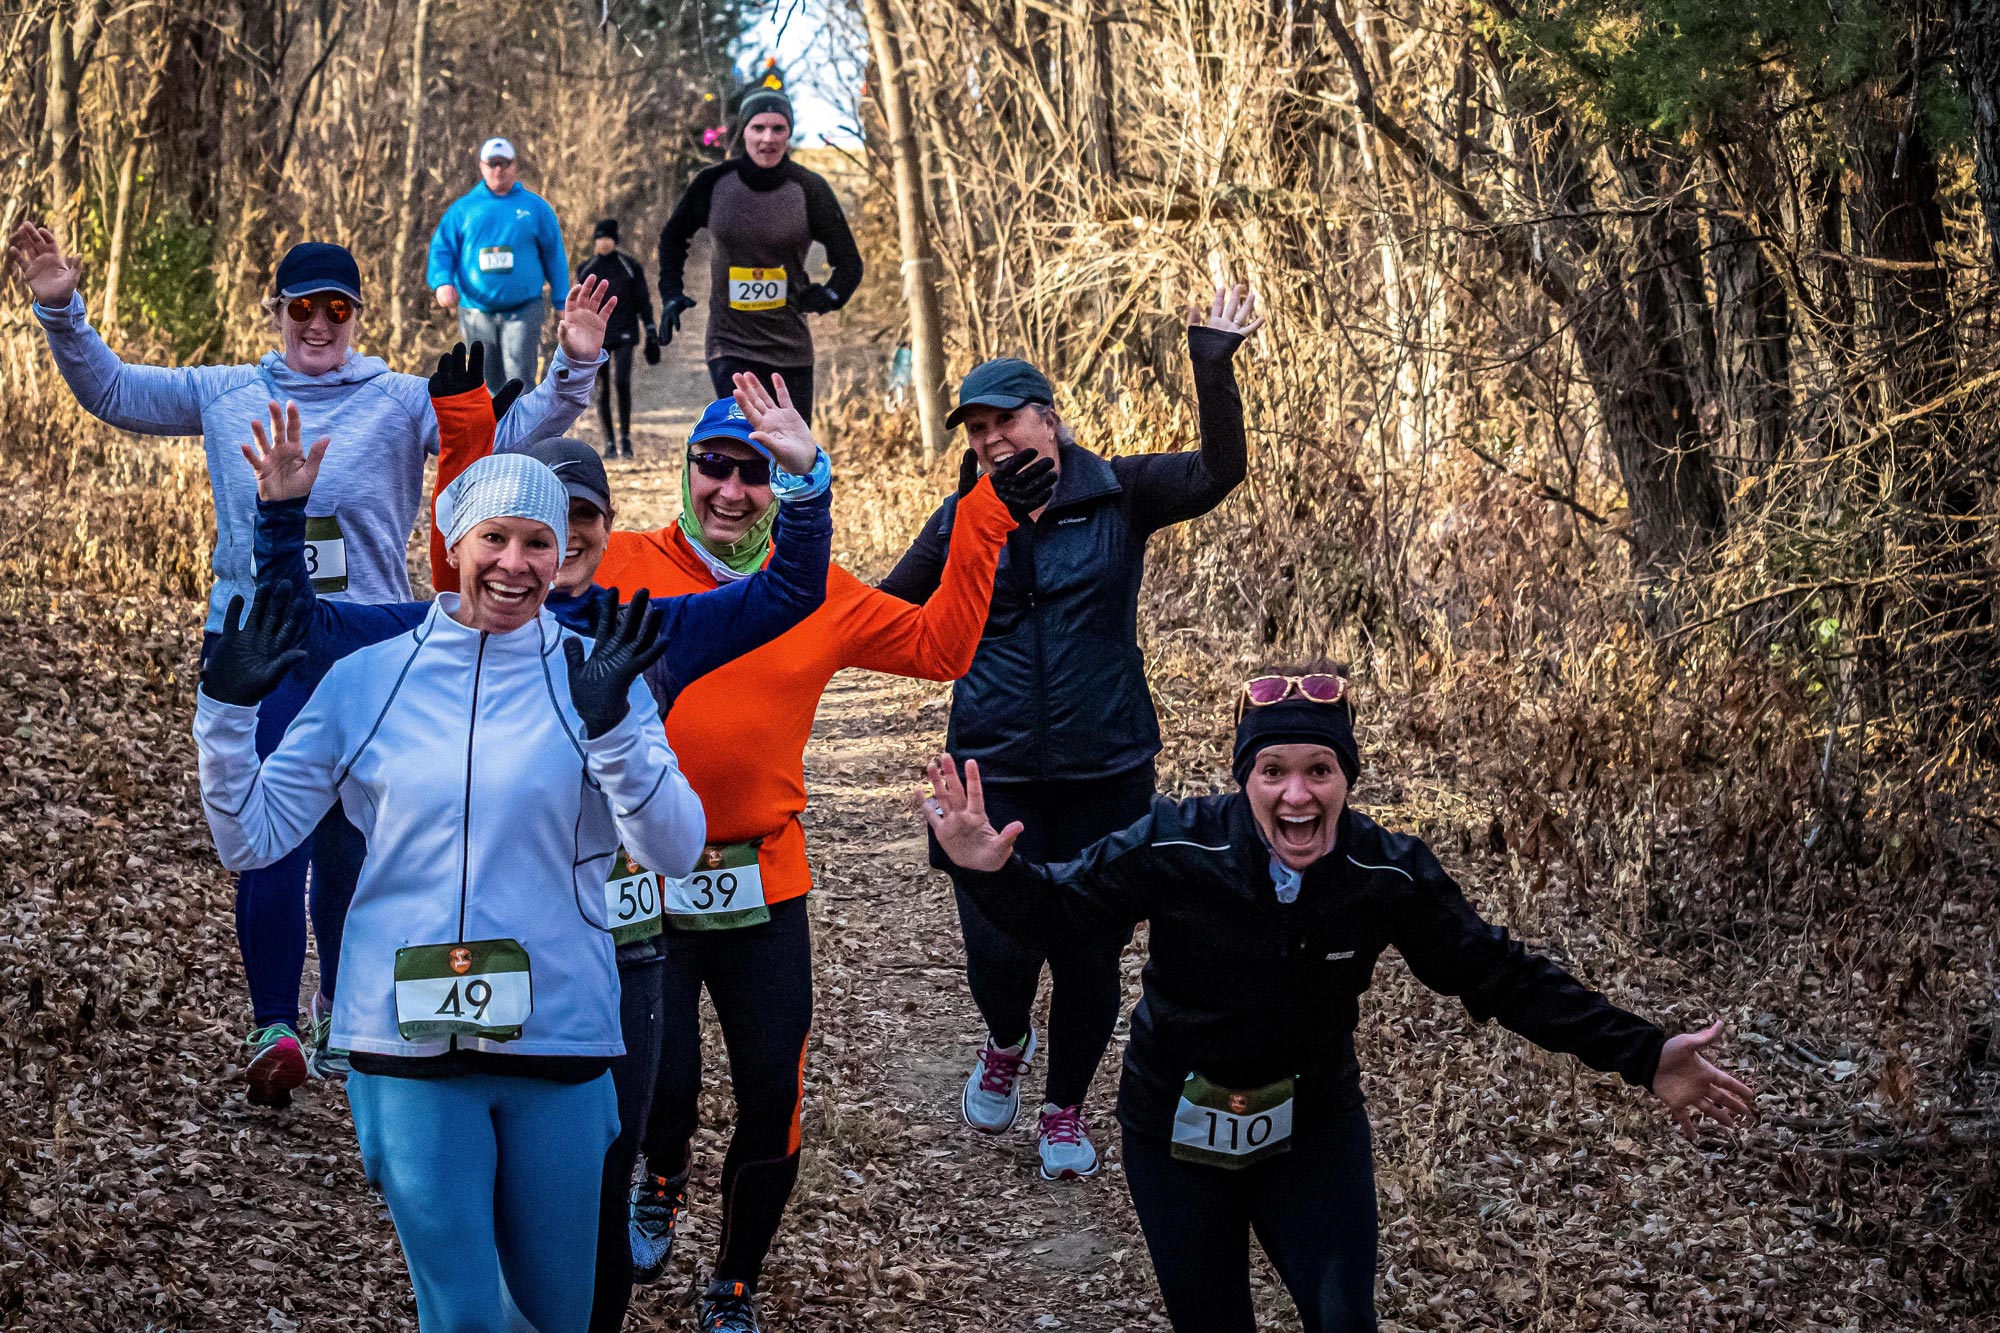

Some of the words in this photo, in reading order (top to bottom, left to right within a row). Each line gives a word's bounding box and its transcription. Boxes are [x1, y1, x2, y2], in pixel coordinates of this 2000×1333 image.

[739, 282, 778, 300] 290
[617, 876, 654, 920] 50
[692, 873, 738, 910] 39
[434, 979, 492, 1020] 49
[1205, 1111, 1273, 1151] 110
